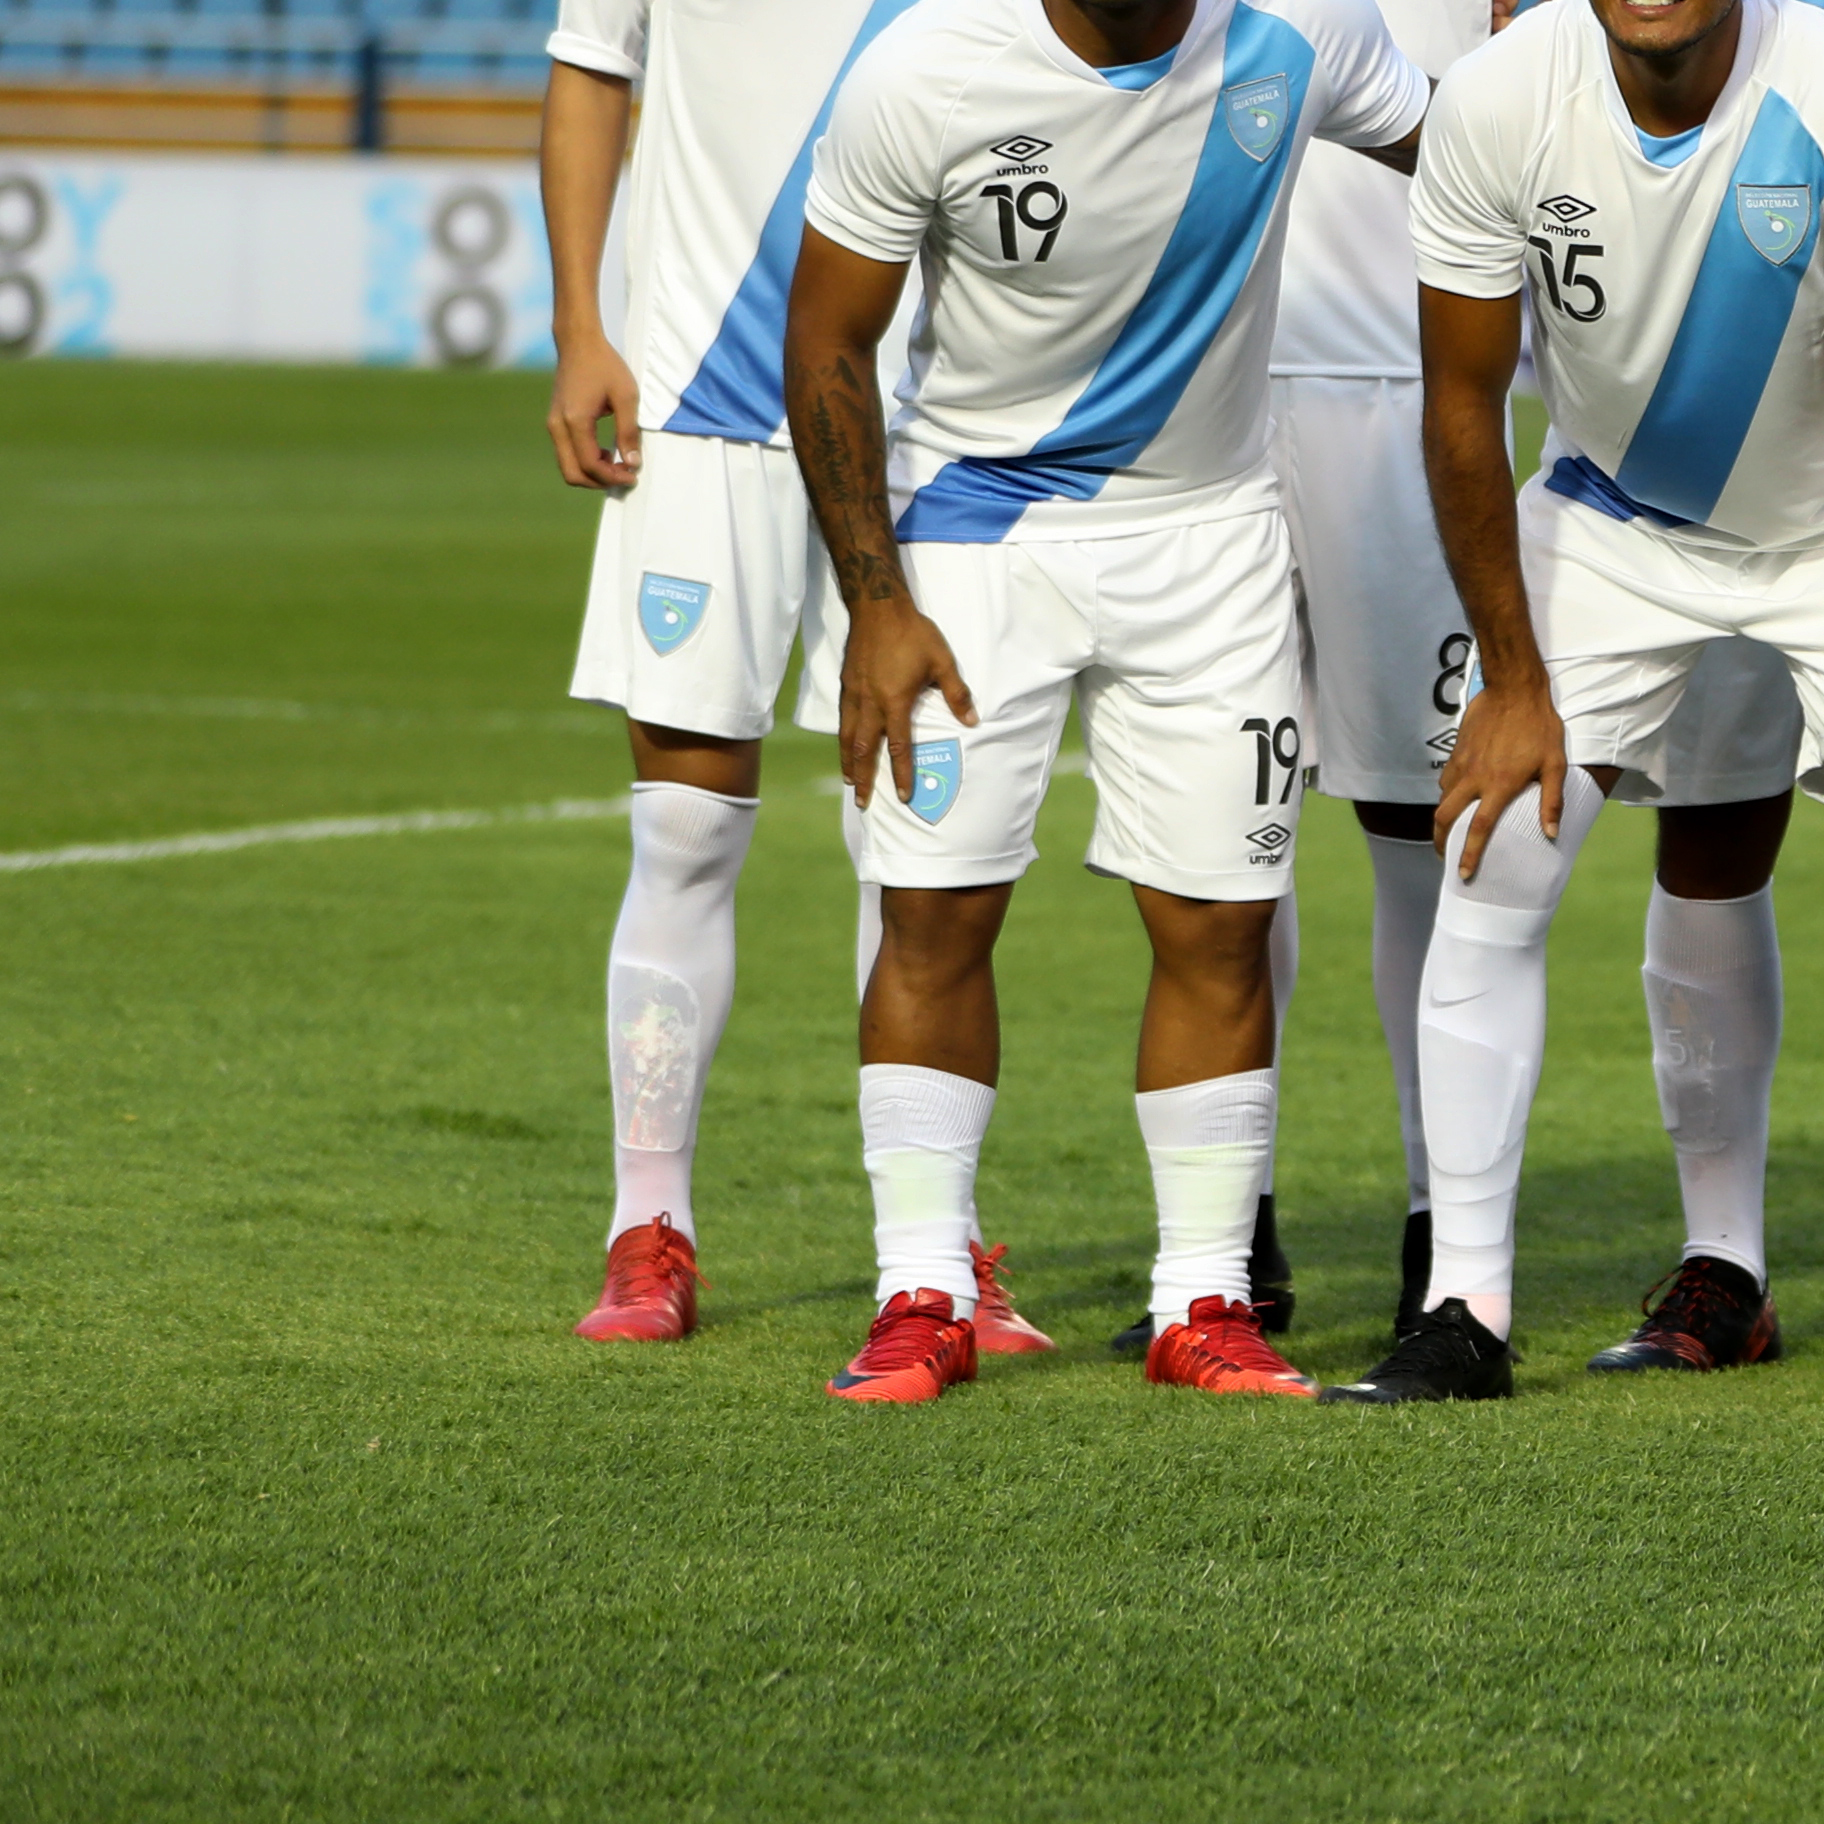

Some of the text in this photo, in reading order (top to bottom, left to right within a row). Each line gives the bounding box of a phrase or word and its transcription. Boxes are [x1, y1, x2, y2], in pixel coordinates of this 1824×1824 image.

[1232, 89, 1280, 111] GUATEMALA
[996, 164, 1049, 177] umbro
[979, 180, 1068, 263] 19
[1745, 198, 1800, 209] GUATEMALA
[1542, 222, 1591, 238] umbro
[1527, 235, 1607, 323] 15
[1432, 632, 1473, 716] 8
[1240, 717, 1299, 806] 19
